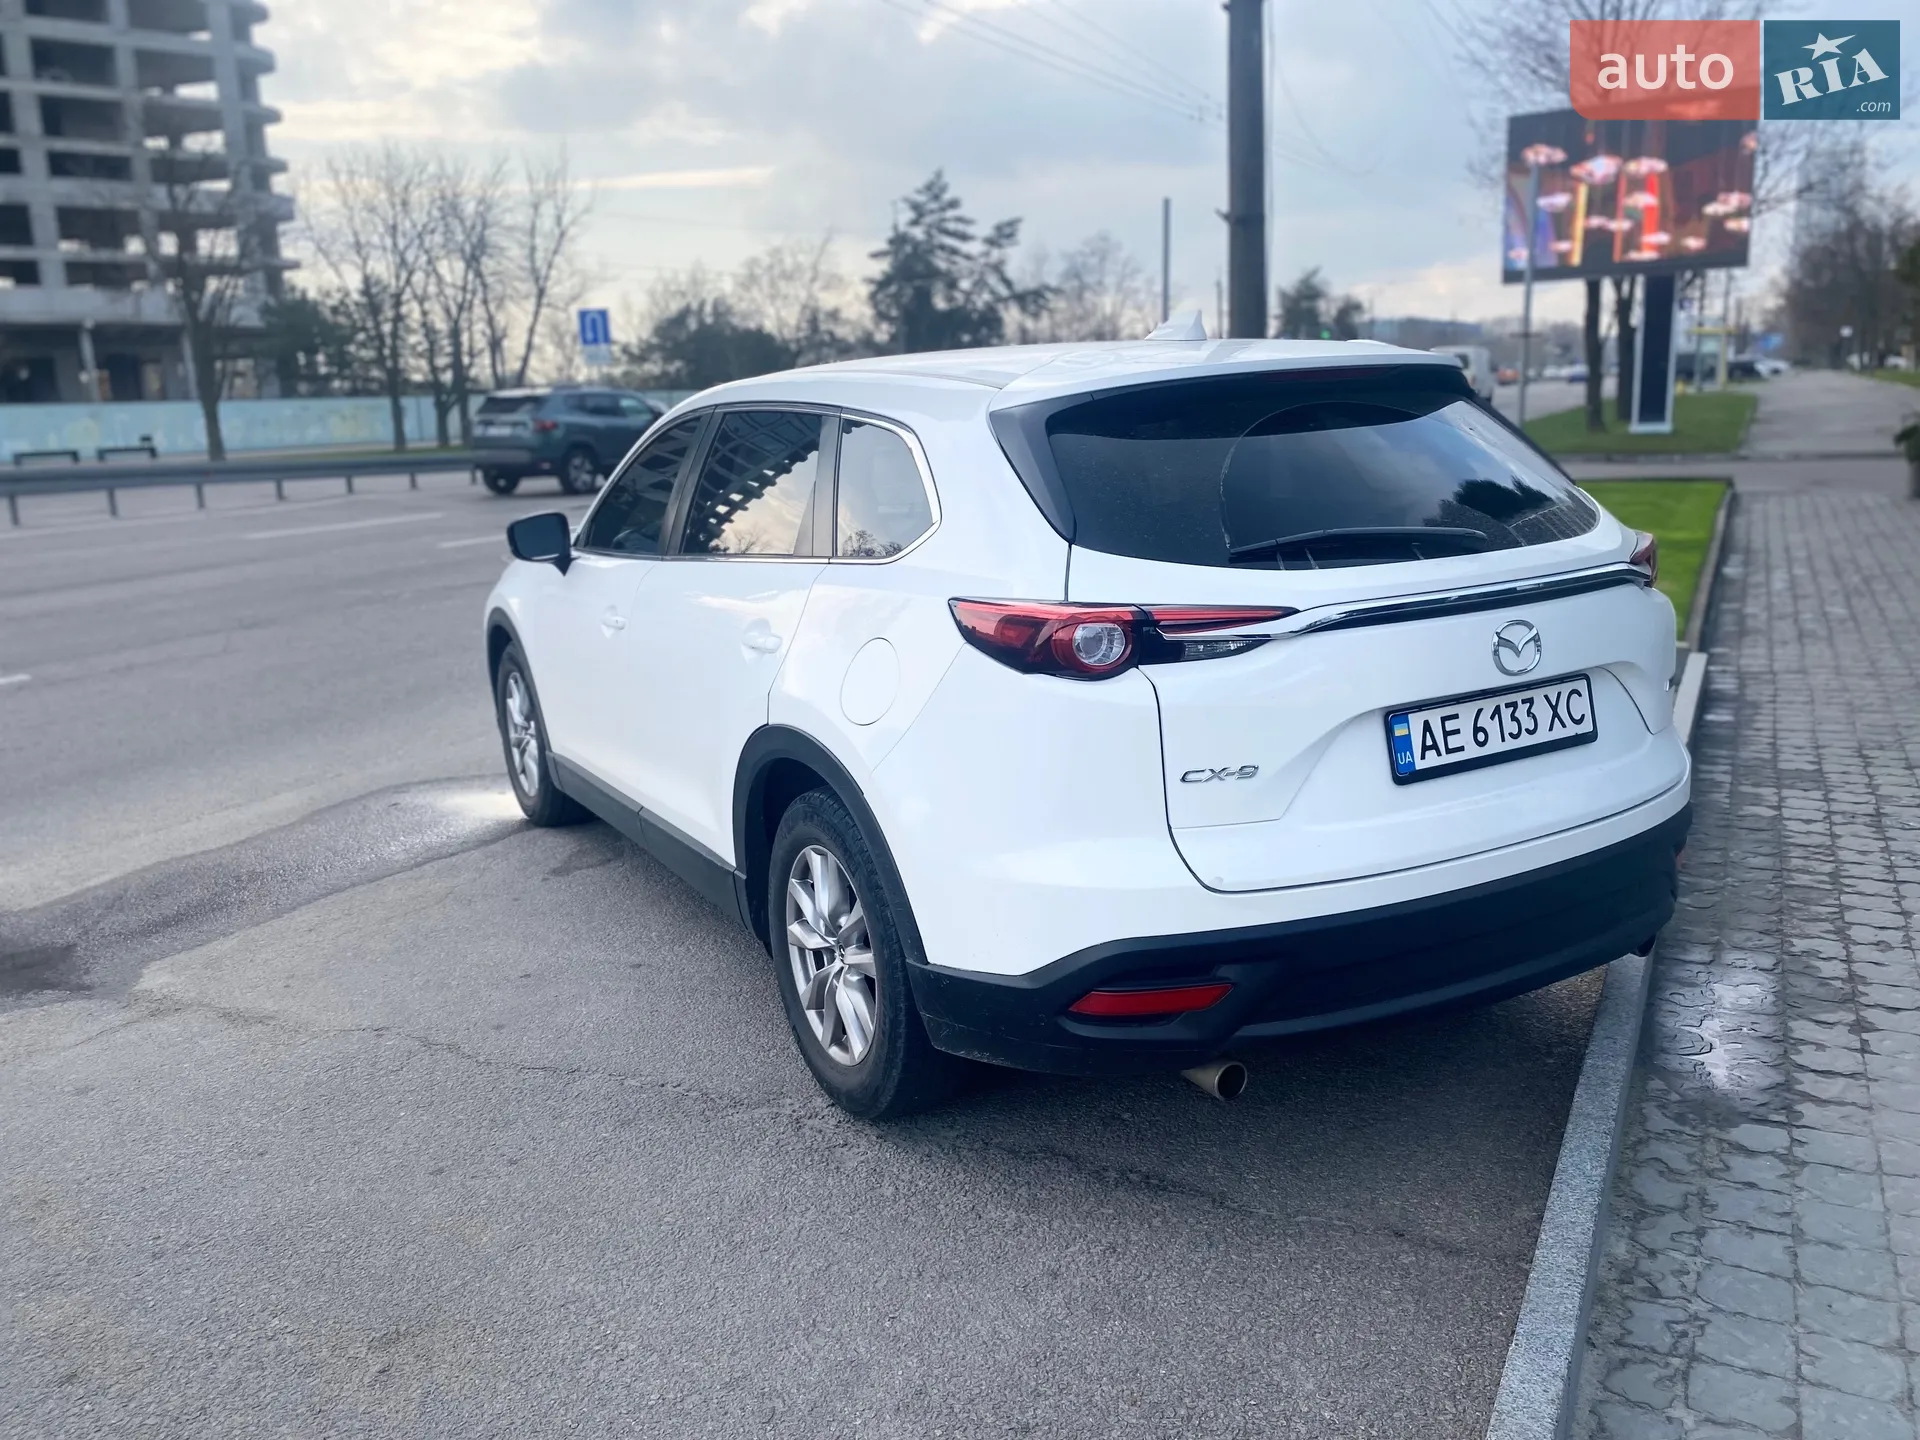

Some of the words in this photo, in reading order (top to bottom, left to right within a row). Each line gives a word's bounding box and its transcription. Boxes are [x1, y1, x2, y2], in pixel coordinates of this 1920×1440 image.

[1420, 713, 1465, 760] AE
[1472, 696, 1538, 748] 6133
[1543, 688, 1586, 732] XC
[1398, 750, 1413, 765] UA
[1180, 765, 1259, 783] CX-9
